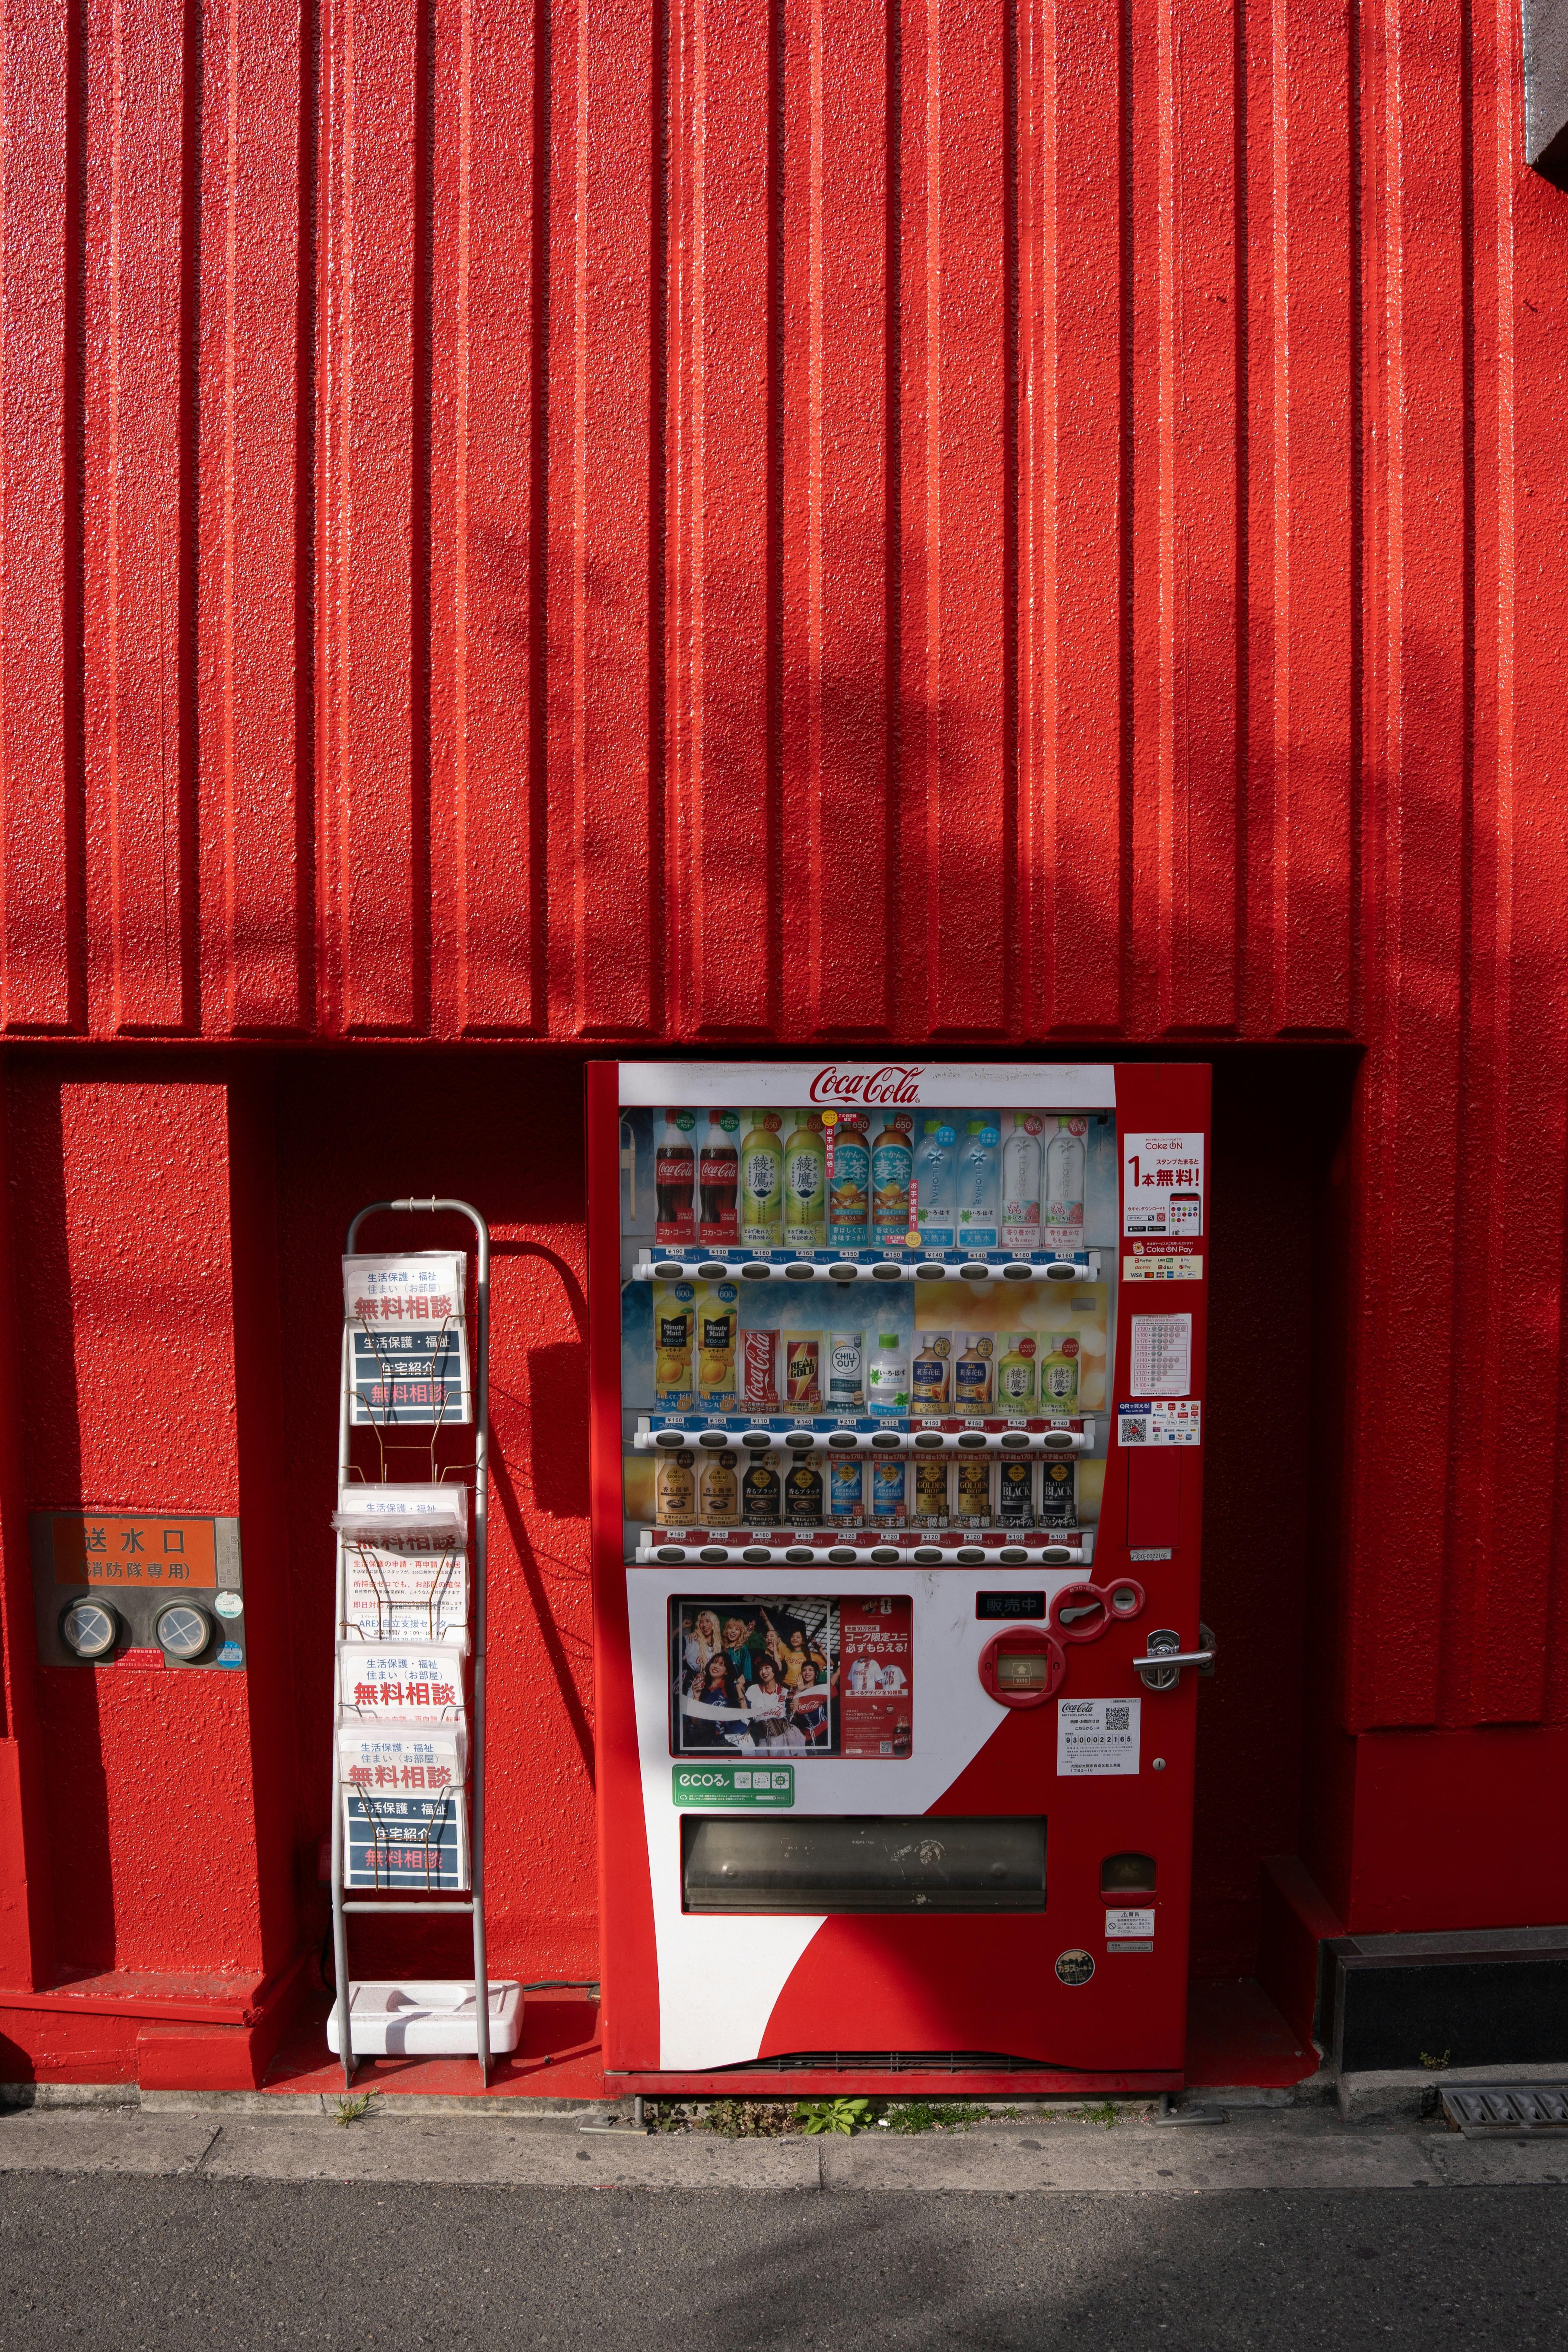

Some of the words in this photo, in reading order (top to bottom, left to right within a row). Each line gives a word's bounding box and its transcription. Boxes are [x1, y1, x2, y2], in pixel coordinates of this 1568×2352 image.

[809, 1066, 926, 1103] Coca-Cola
[1026, 1121, 1041, 1131] もも
[1169, 1141, 1182, 1149] ON
[658, 1162, 693, 1178] Coca-Cola
[753, 1155, 770, 1187] 綾鷹
[874, 1159, 910, 1179] 麦茶
[1128, 1155, 1199, 1187] 1本無料!
[1179, 1246, 1193, 1254] Pay
[368, 1272, 437, 1282] 生活保護・福祉
[354, 1295, 452, 1321] 無料相談
[363, 1336, 451, 1348] 生活保護・福祉
[382, 1362, 435, 1376] 住宅紹介
[745, 1333, 770, 1401] Coca-Cola
[791, 1357, 814, 1370] REAL
[791, 1366, 814, 1378] GOLD
[1010, 1368, 1022, 1390] 綾鷹
[371, 1384, 447, 1403] 無料相談
[1003, 1486, 1030, 1496] BLACK
[366, 1503, 437, 1512] 生活保護・福祉
[843, 1516, 863, 1527] 王道
[928, 1516, 948, 1527] 微糖
[1009, 1517, 1033, 1526] シャキッと
[82, 1527, 184, 1554] 送水口
[355, 1534, 458, 1551] 無料相談
[353, 1580, 461, 1588] 所持金ゼロでも、お部屋の確保
[986, 1598, 1037, 1613] 販売中
[846, 1633, 908, 1642] コーク限定ユニ
[846, 1643, 907, 1653] 必ずもらえる!
[366, 1659, 438, 1669] 生活保護・福祉
[884, 1670, 895, 1685] 26
[354, 1682, 457, 1706] 無料相談
[1062, 1702, 1094, 1713] Coca-Cola
[361, 1743, 434, 1753] 生活保護・福祉
[348, 1765, 451, 1788] 無料相談
[358, 1802, 447, 1816] 生活保護・福祉
[375, 1827, 431, 1842] 住宅紹介
[365, 1849, 443, 1870] 無料相談
